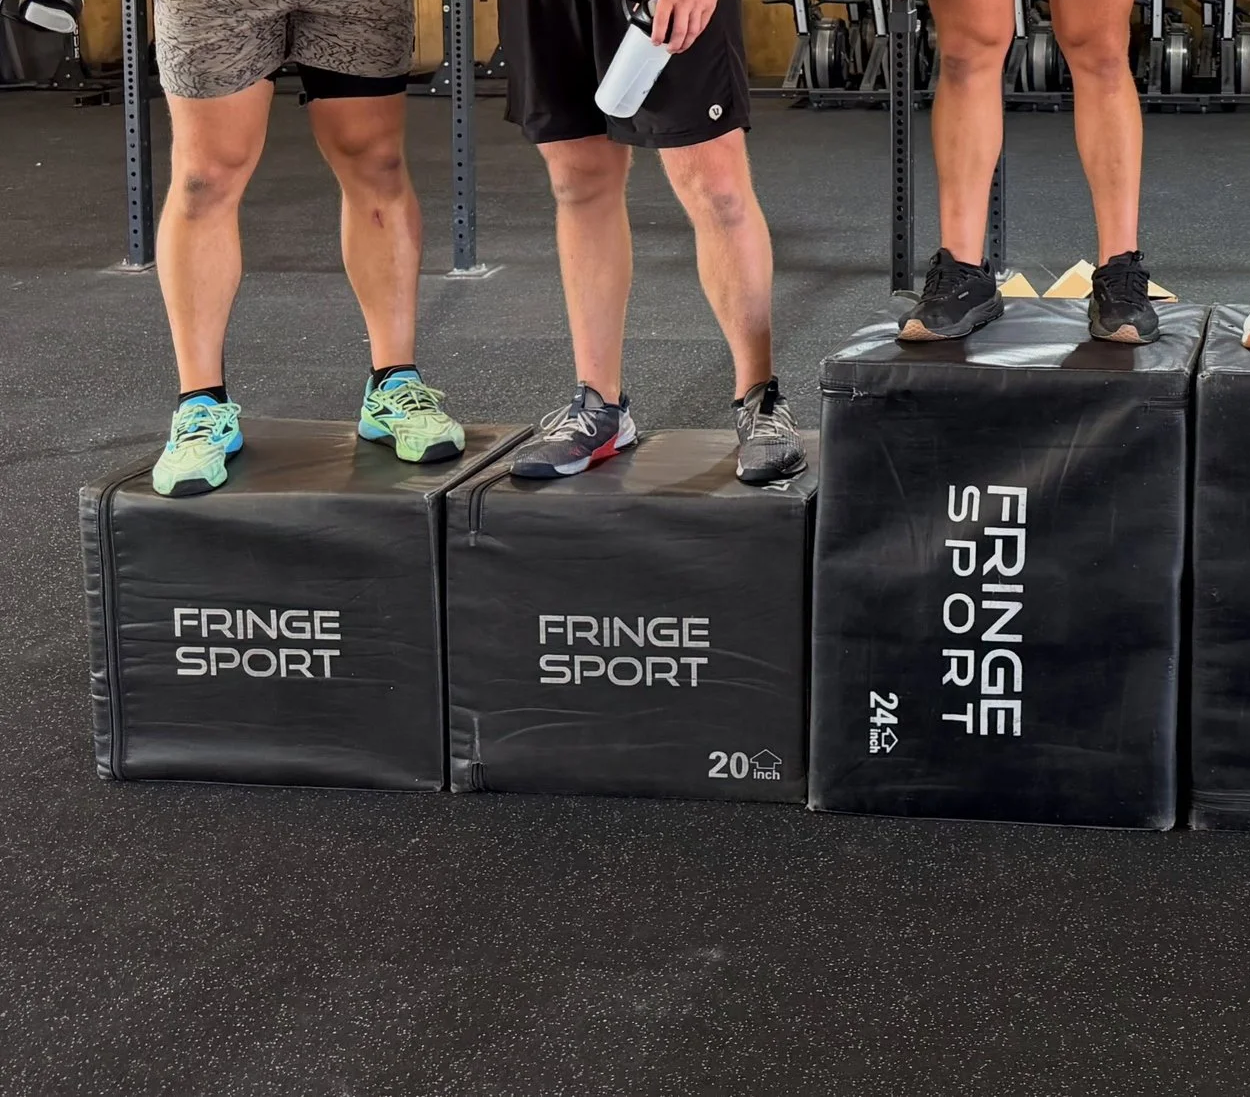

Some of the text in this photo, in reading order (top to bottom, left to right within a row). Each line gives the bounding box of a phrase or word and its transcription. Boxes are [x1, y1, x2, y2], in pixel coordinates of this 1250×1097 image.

[174, 607, 341, 640] FRINGE
[941, 484, 980, 736] SPORT
[980, 484, 1027, 737] FRINGE
[538, 614, 711, 648] FRINGE
[176, 646, 341, 678] SPORT
[538, 655, 709, 687] SPORT
[868, 691, 899, 754] 24 inch
[707, 750, 781, 781] 20 inch
